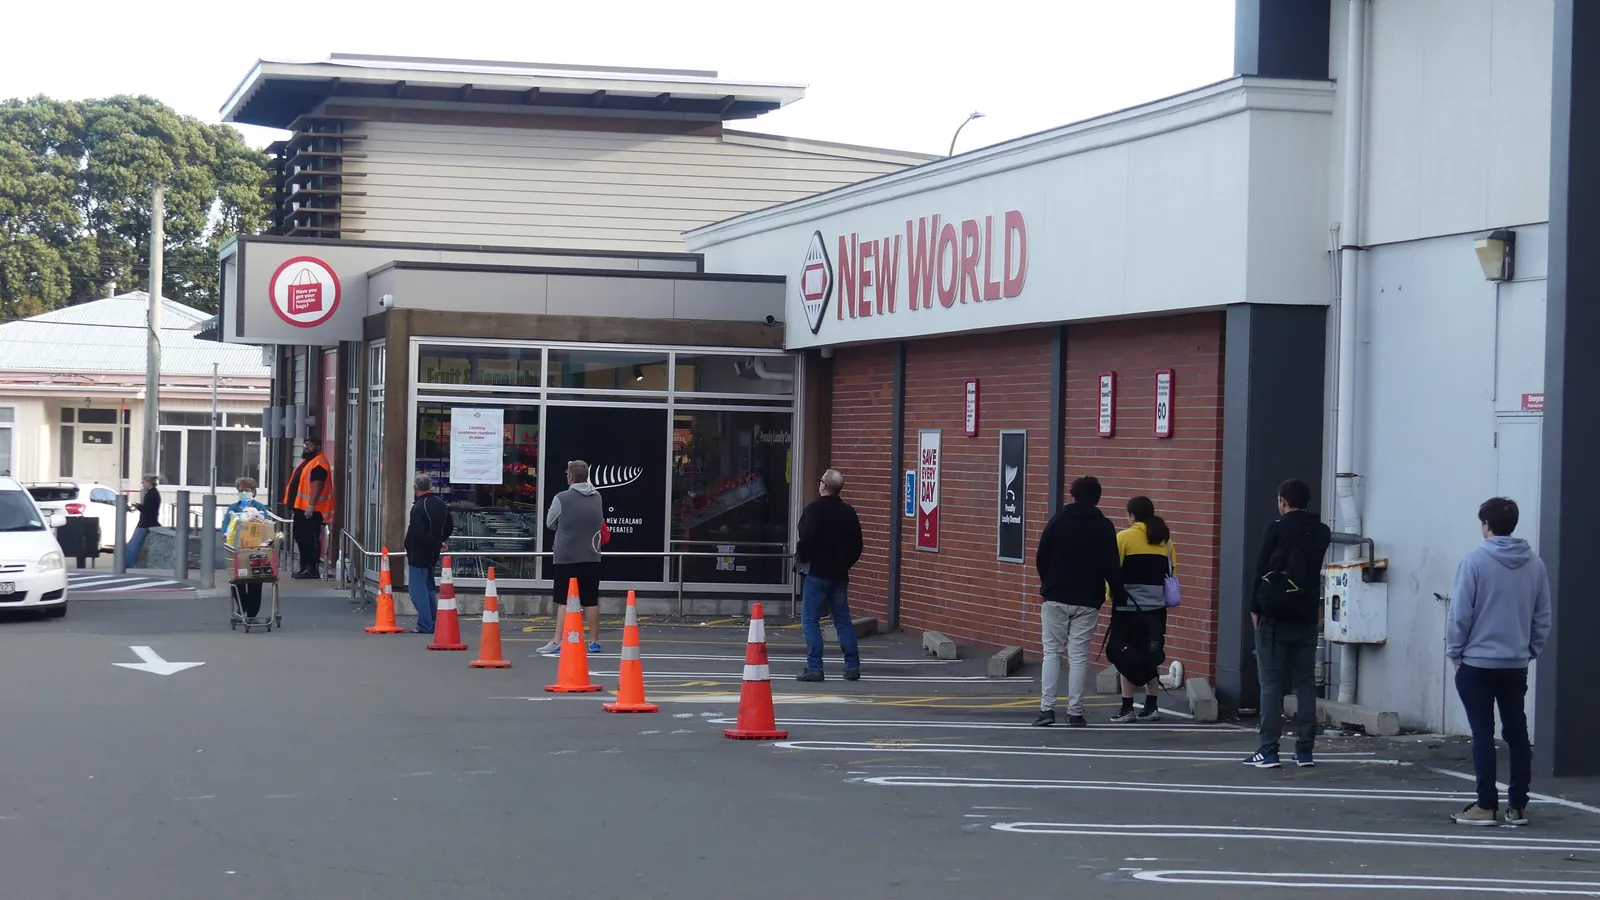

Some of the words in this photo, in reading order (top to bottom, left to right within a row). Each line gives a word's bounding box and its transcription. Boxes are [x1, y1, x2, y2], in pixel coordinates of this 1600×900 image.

[837, 232, 902, 320] NEW
[906, 209, 1029, 311] WORLD
[1528, 395, 1544, 403] Emergenc
[1158, 402, 1166, 420] 60
[922, 449, 936, 466] SAVE
[922, 467, 936, 480] EVERY
[921, 481, 936, 502] DAY
[618, 517, 643, 525] ZEALAND
